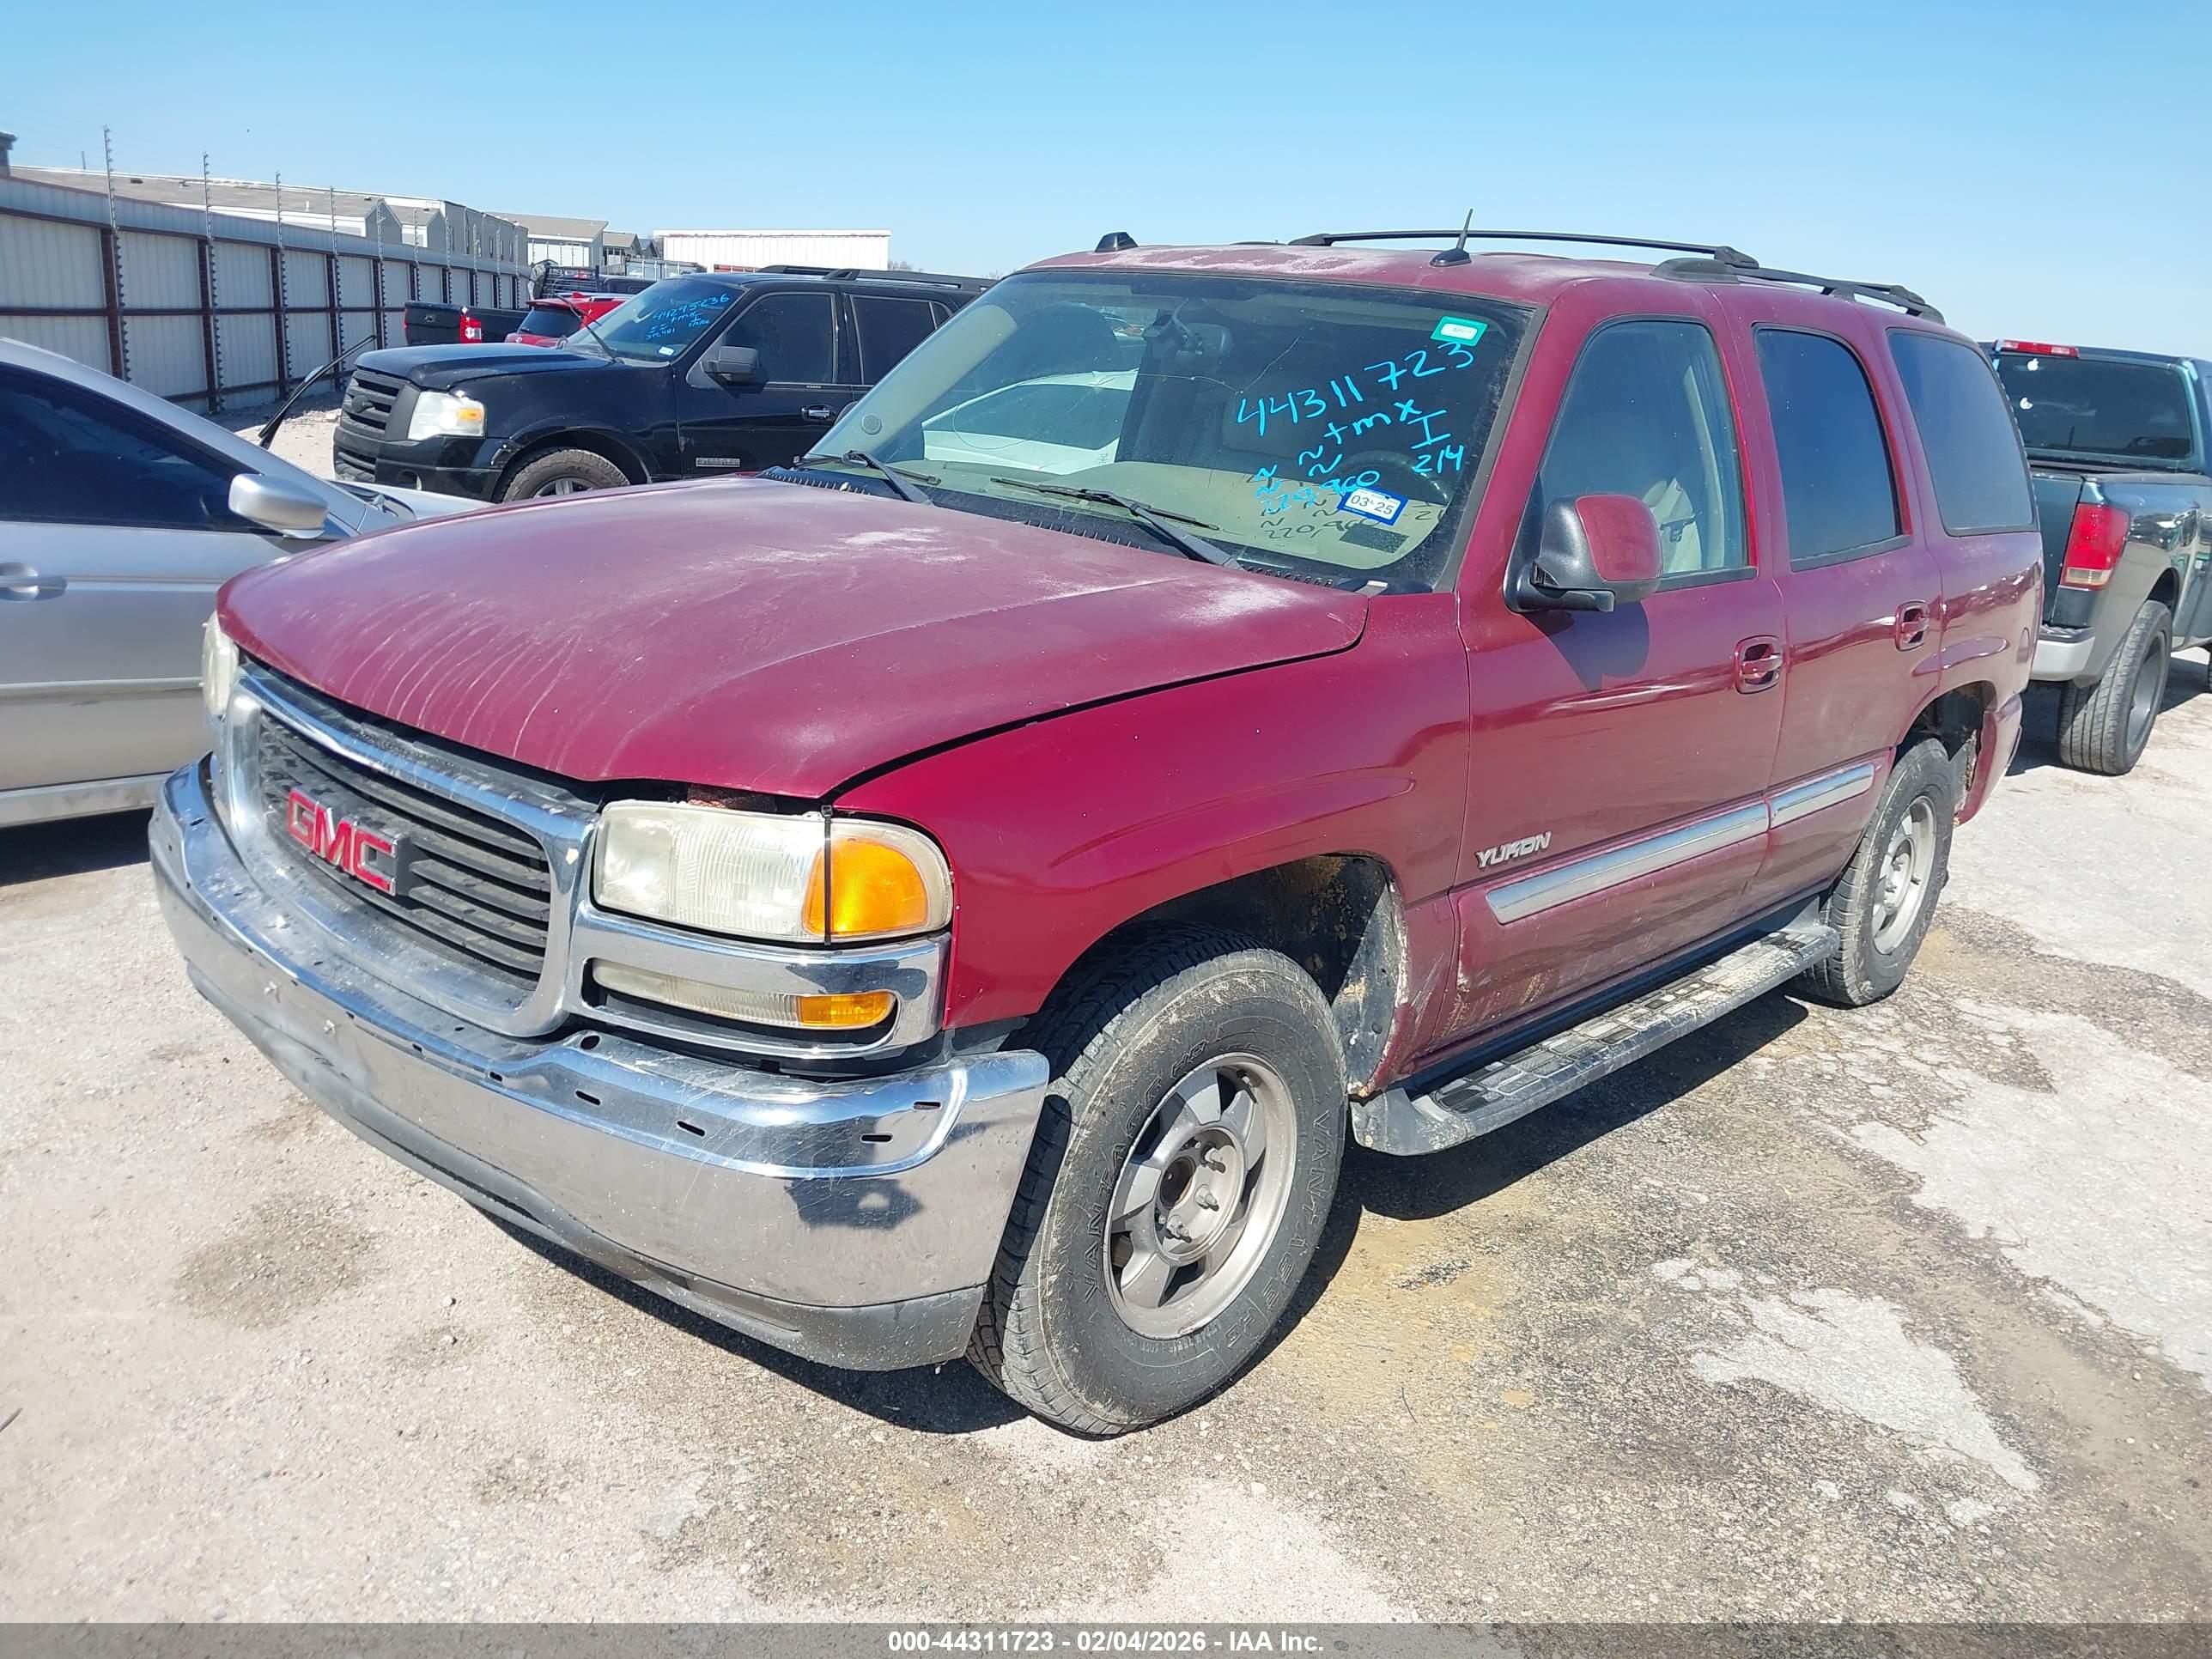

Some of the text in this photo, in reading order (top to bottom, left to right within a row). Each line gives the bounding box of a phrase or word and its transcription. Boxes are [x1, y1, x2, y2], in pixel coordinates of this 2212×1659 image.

[1351, 495, 1370, 507] 03
[1374, 501, 1395, 514] 25
[288, 788, 398, 896] GMC
[1476, 830, 1552, 868] YUKON
